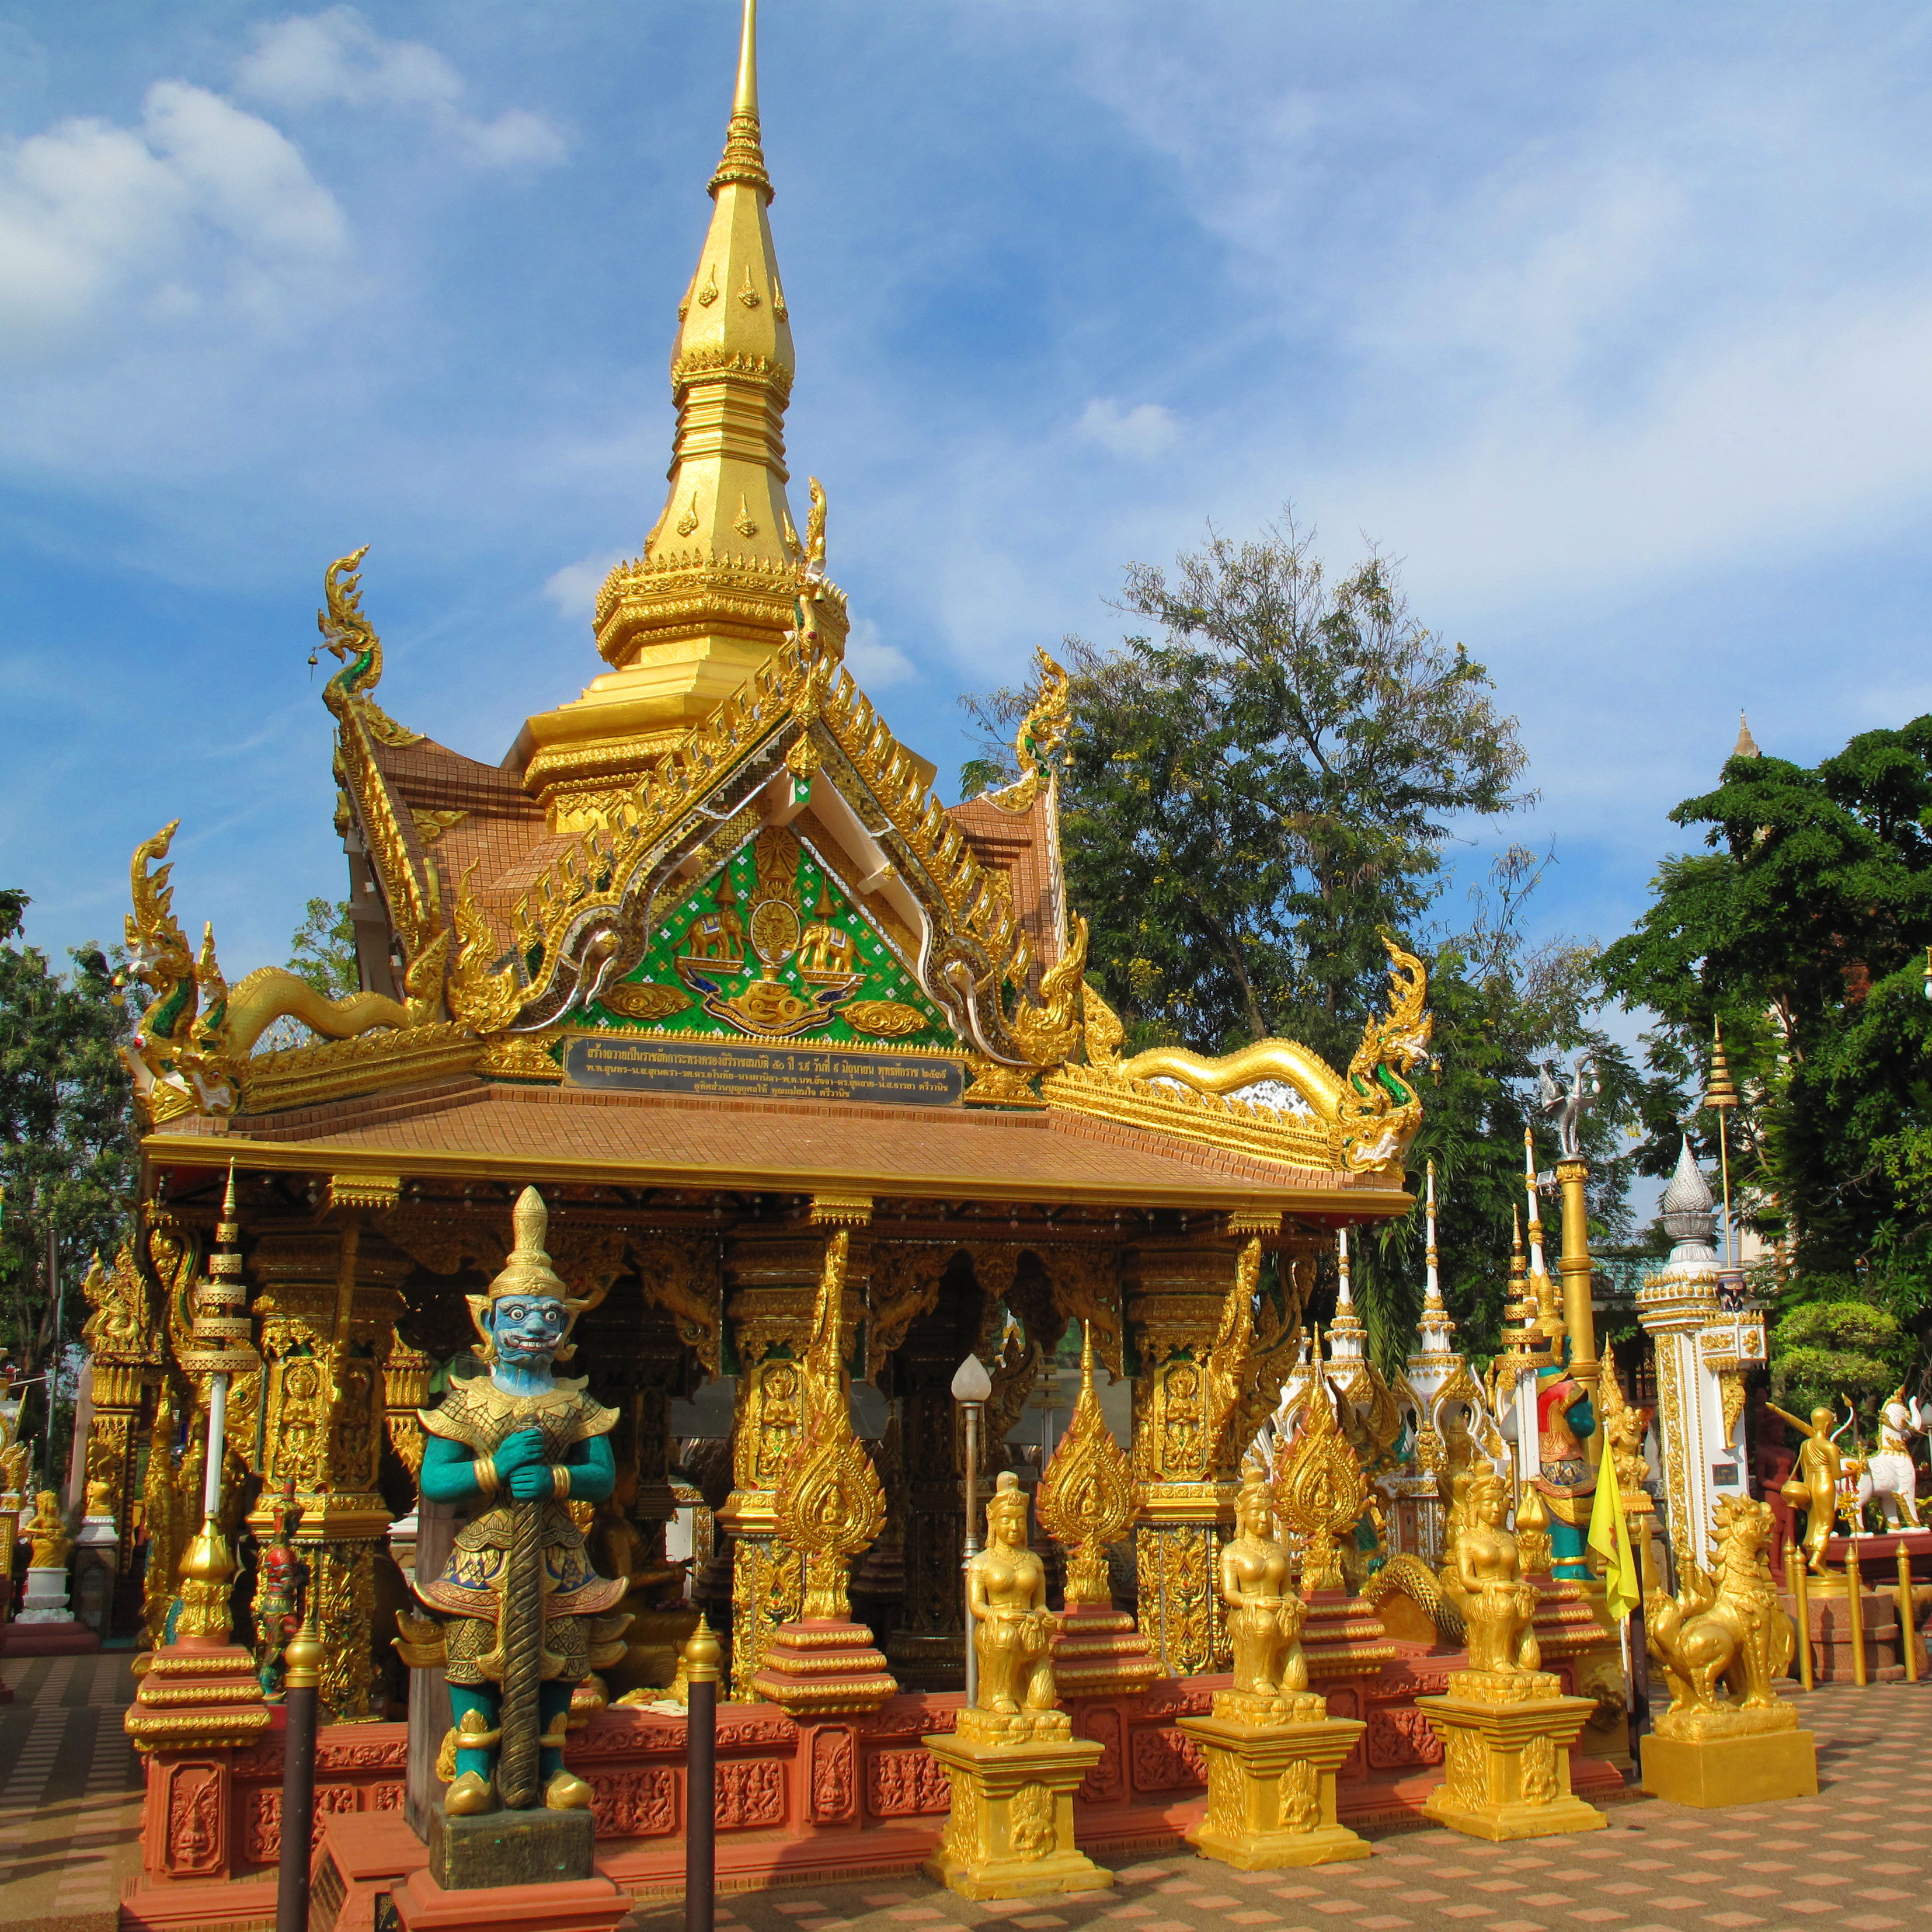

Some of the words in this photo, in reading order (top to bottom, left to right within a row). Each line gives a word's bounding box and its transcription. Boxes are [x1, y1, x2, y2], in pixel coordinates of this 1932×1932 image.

[772, 1059, 785, 1070] ๕๐
[787, 1056, 795, 1070] ปี
[813, 1054, 830, 1073] วันที่
[833, 1062, 840, 1073] ๙
[842, 1060, 875, 1079] มิถุนายน
[878, 1062, 919, 1080] พุทธศักราช
[922, 1068, 947, 1080] ๒๕๓๙
